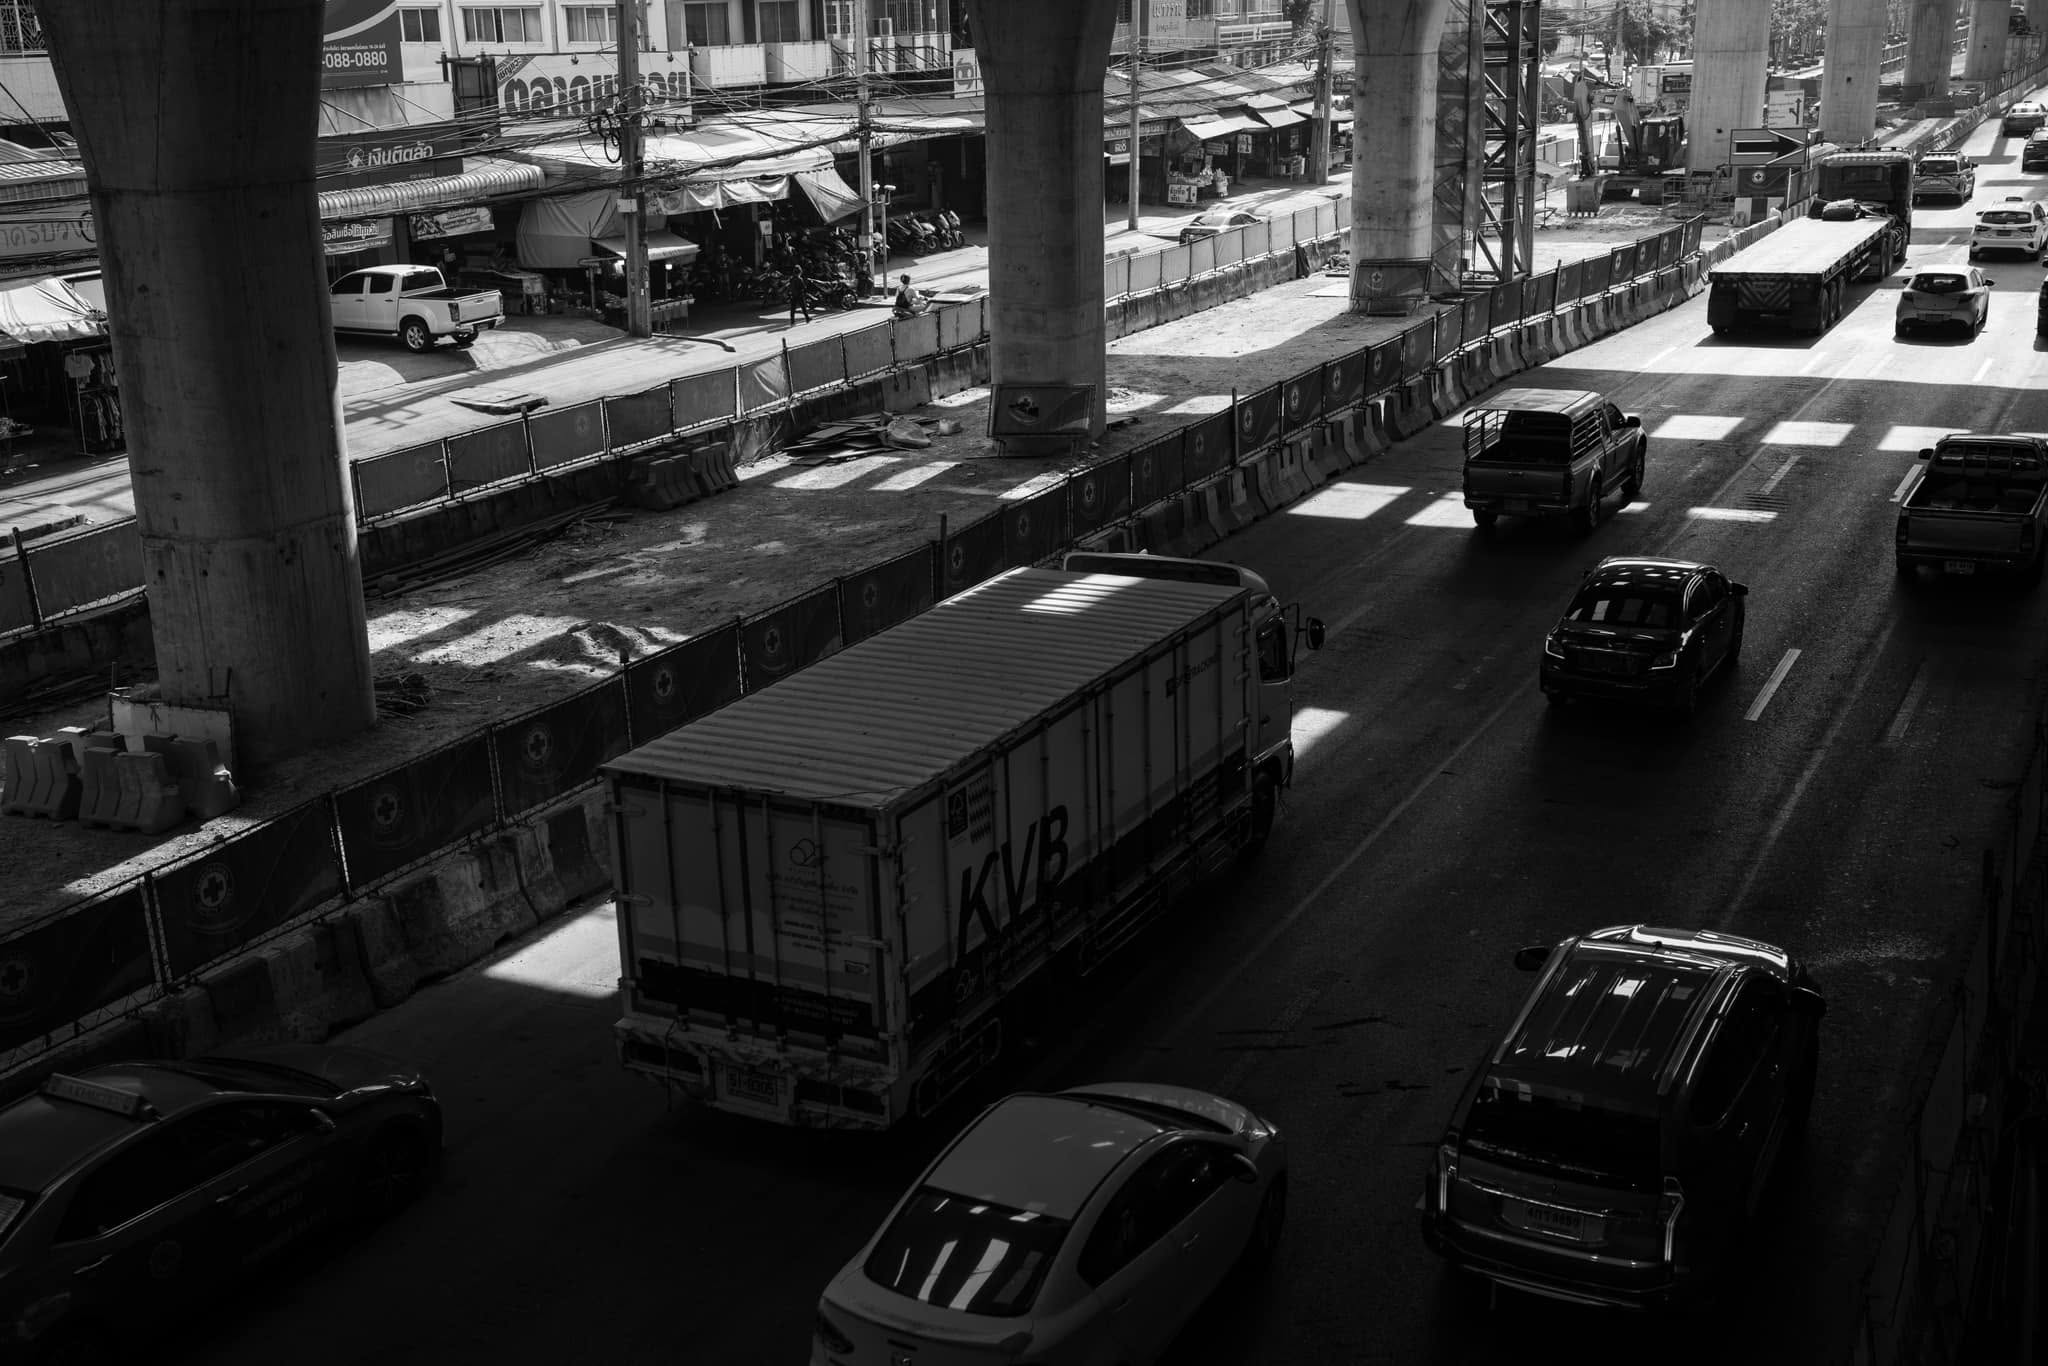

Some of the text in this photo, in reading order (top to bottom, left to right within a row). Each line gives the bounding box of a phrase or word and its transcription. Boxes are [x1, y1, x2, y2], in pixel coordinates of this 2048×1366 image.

[367, 140, 434, 167] เงินติดล้อ
[956, 804, 1069, 966] KVB
